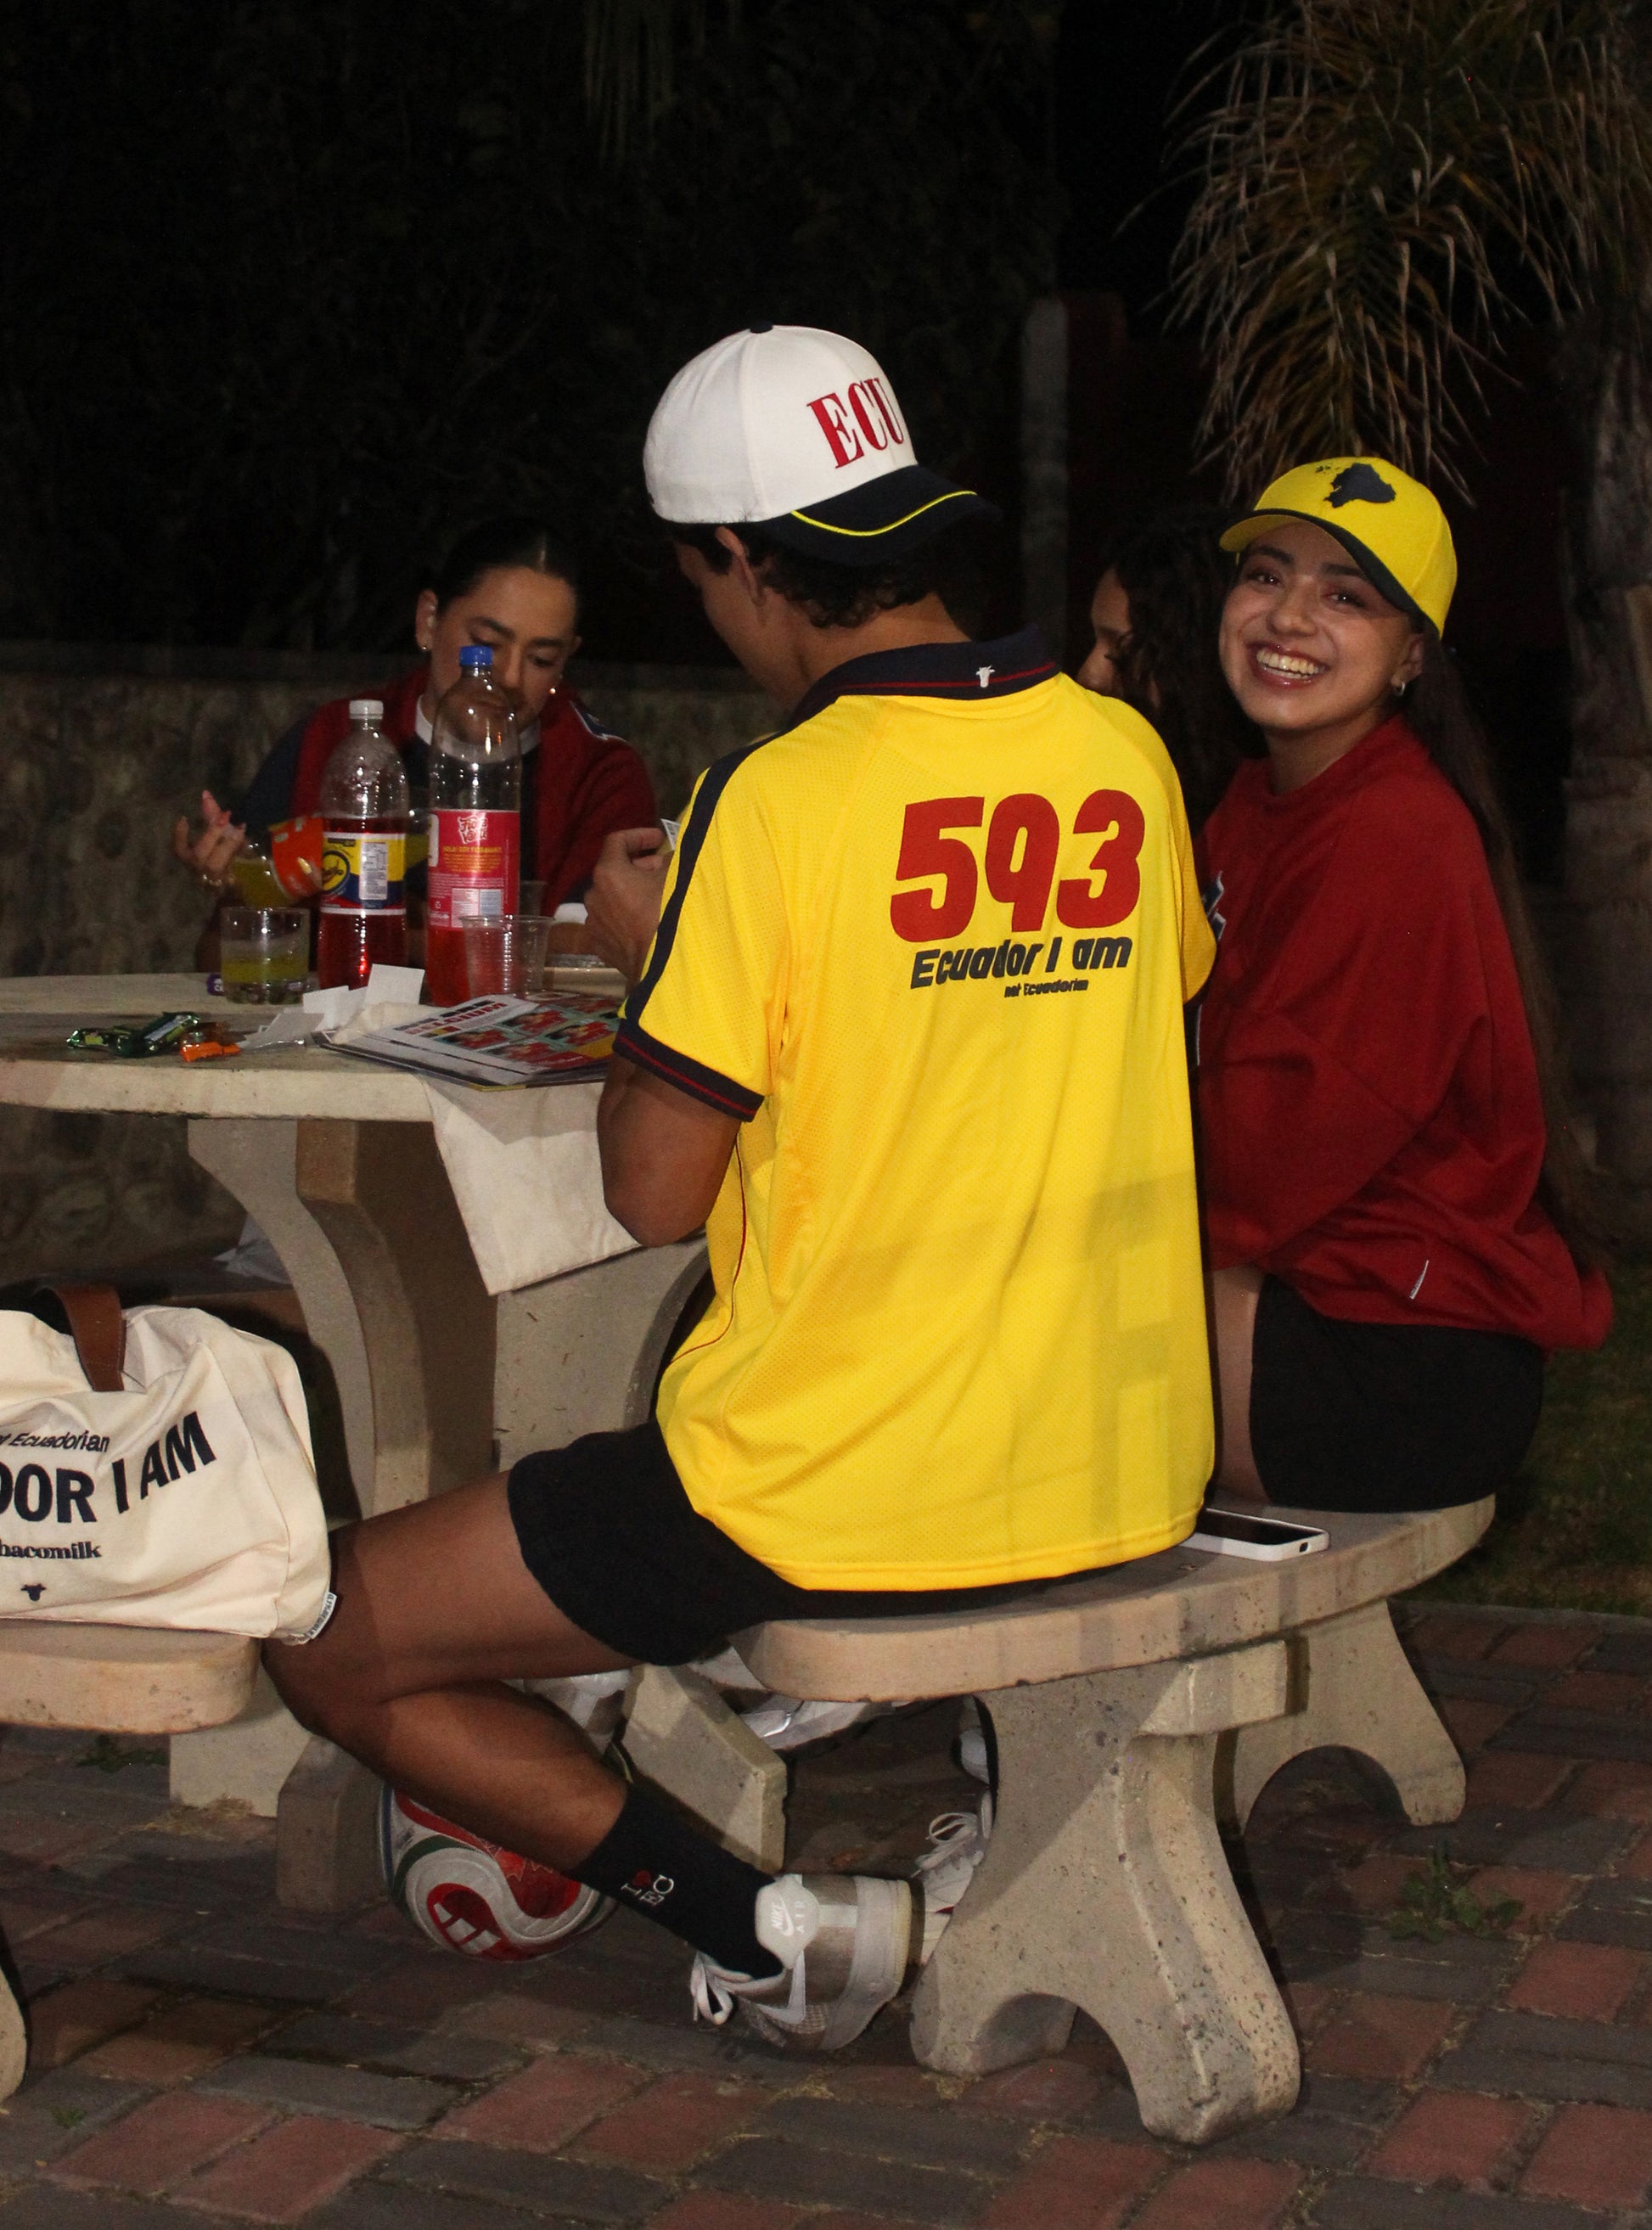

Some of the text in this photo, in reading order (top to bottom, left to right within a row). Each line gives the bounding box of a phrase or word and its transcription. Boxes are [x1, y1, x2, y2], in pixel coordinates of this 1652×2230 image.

[806, 377, 904, 469] ECU
[890, 789, 1145, 942] 593
[910, 936, 1132, 989] Ecuador I am
[8, 1430, 110, 1452] Ecuadorian
[111, 1458, 130, 1514] I
[140, 1411, 216, 1500] AM
